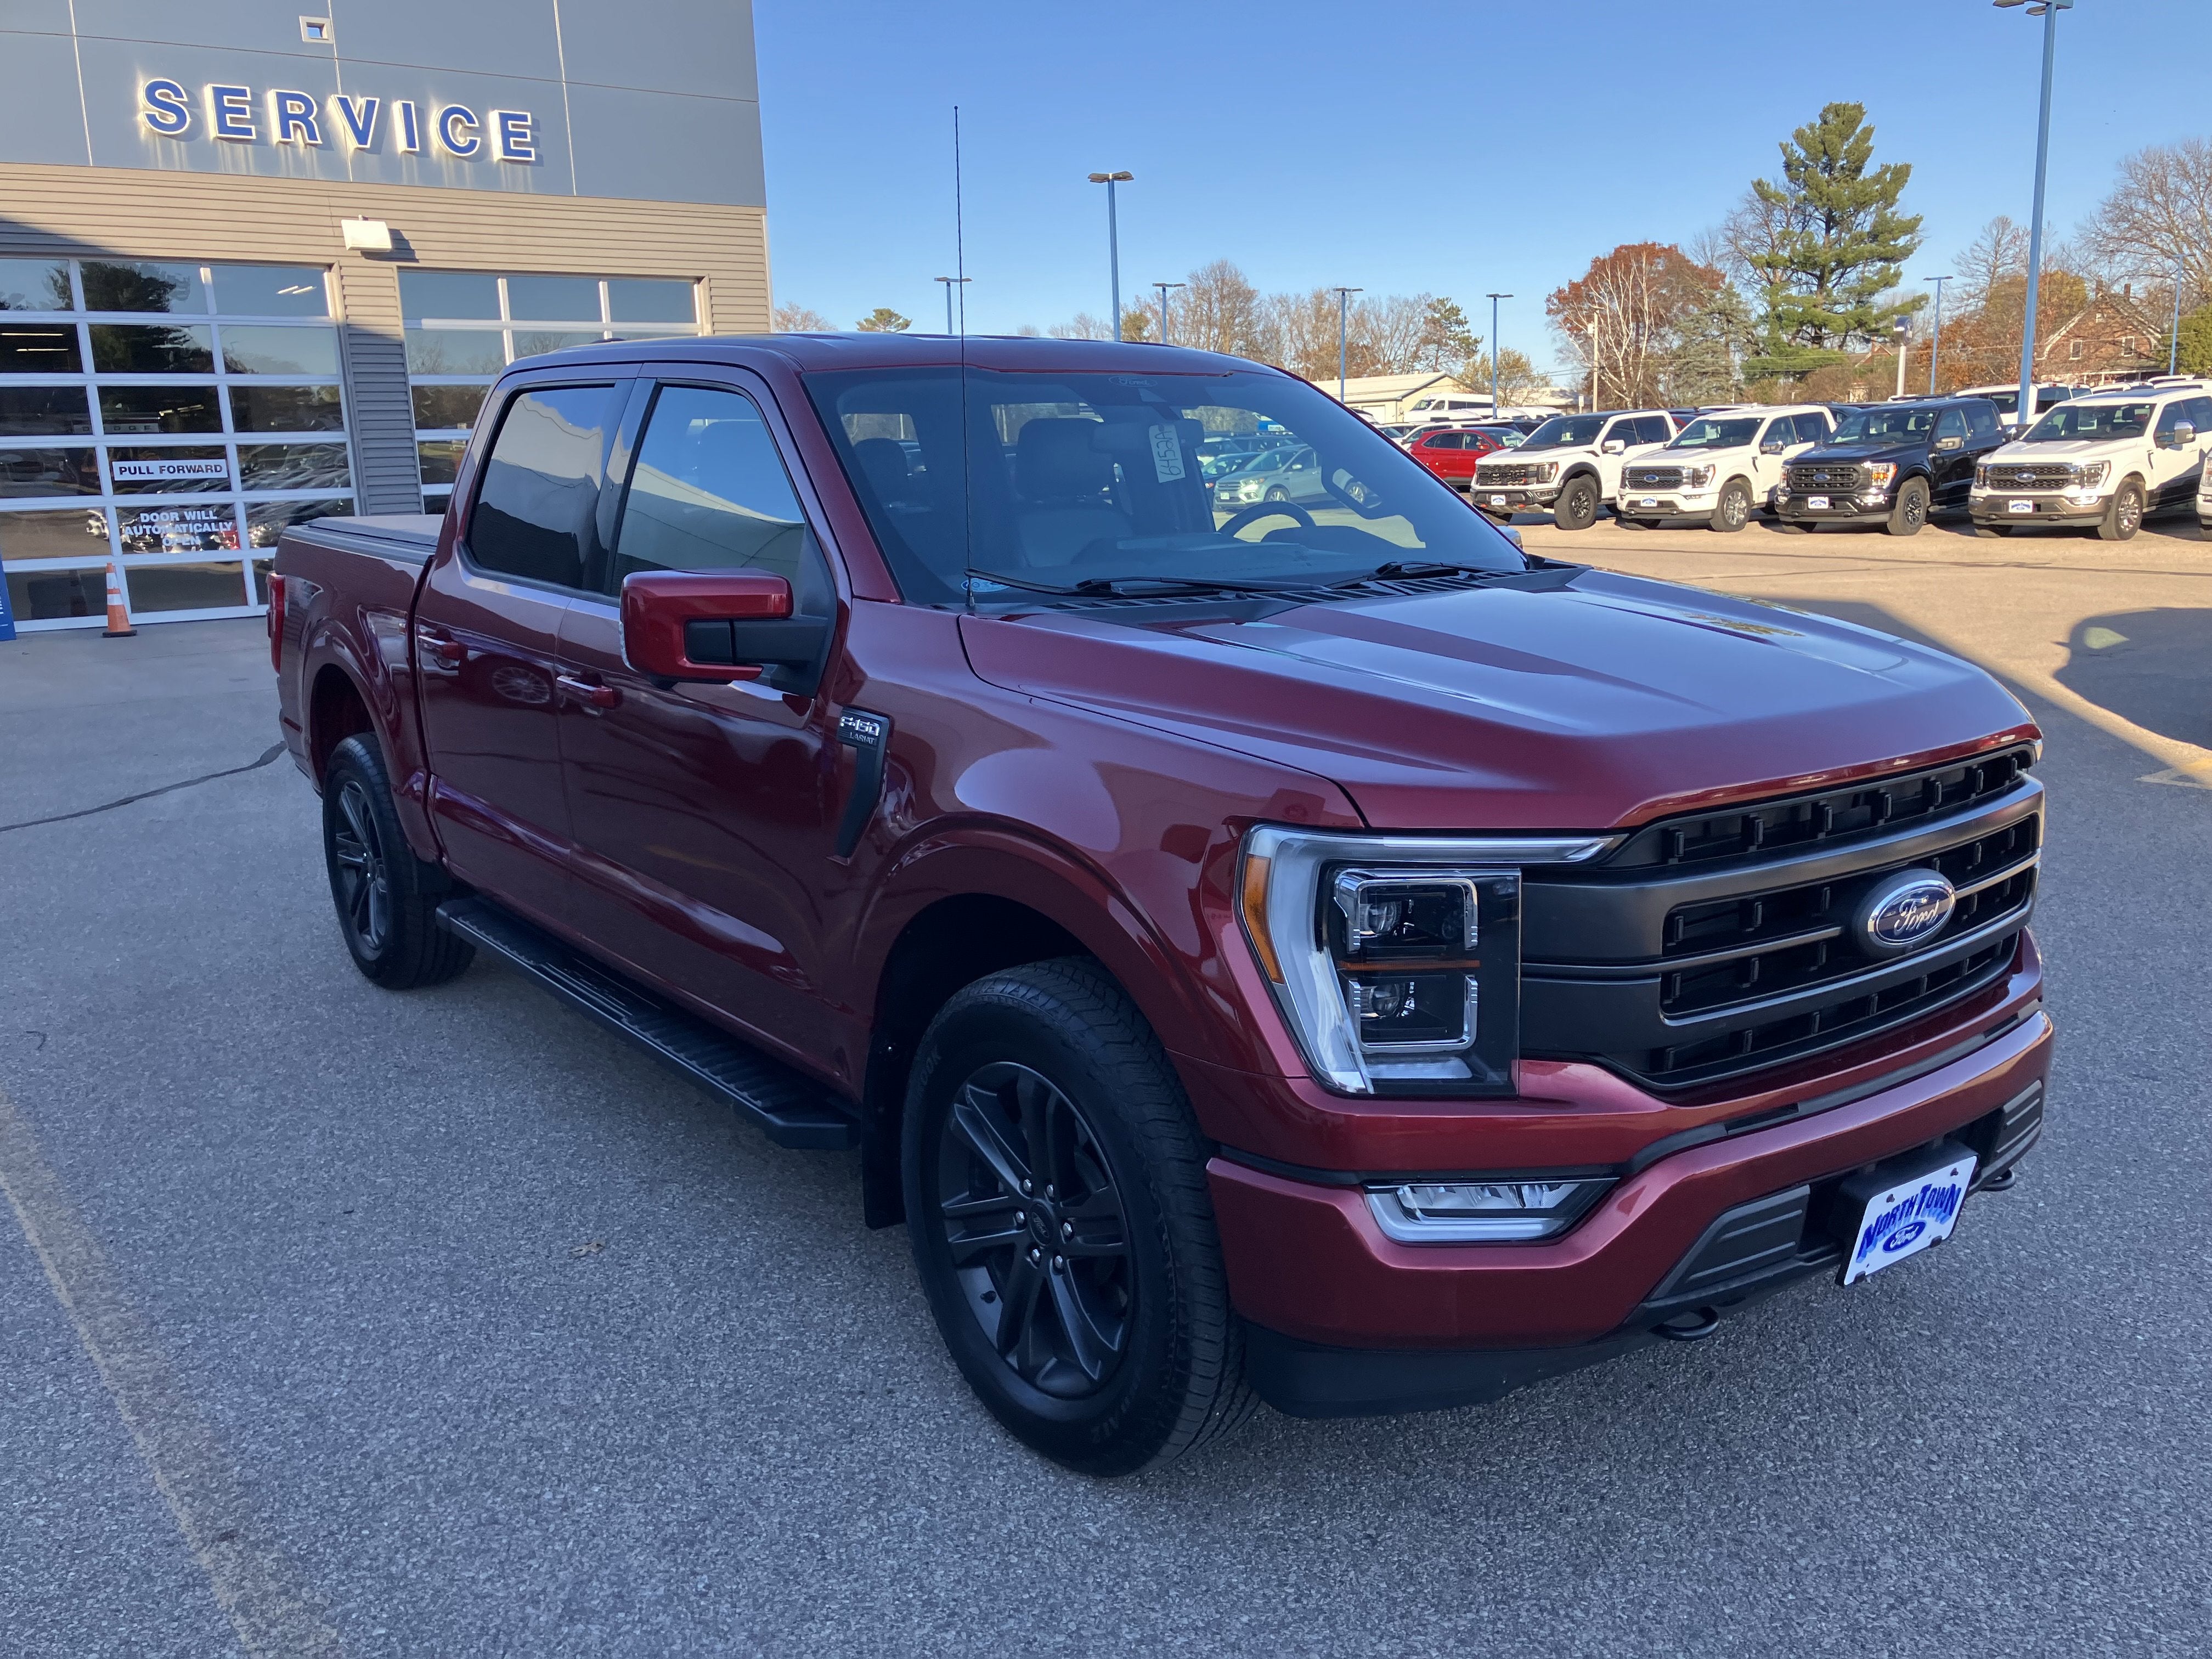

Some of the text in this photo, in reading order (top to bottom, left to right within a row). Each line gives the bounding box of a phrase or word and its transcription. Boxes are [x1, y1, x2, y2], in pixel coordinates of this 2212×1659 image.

[140, 77, 535, 162] SERVICE
[119, 464, 223, 476] PULL FORWARD
[140, 510, 218, 523] DOOR WILL
[125, 522, 233, 536] AUTOMATICALLY
[162, 535, 201, 547] OPEN
[840, 716, 880, 736] F-150
[1894, 895, 1940, 936] Ford
[1889, 1224, 1920, 1249] Ford
